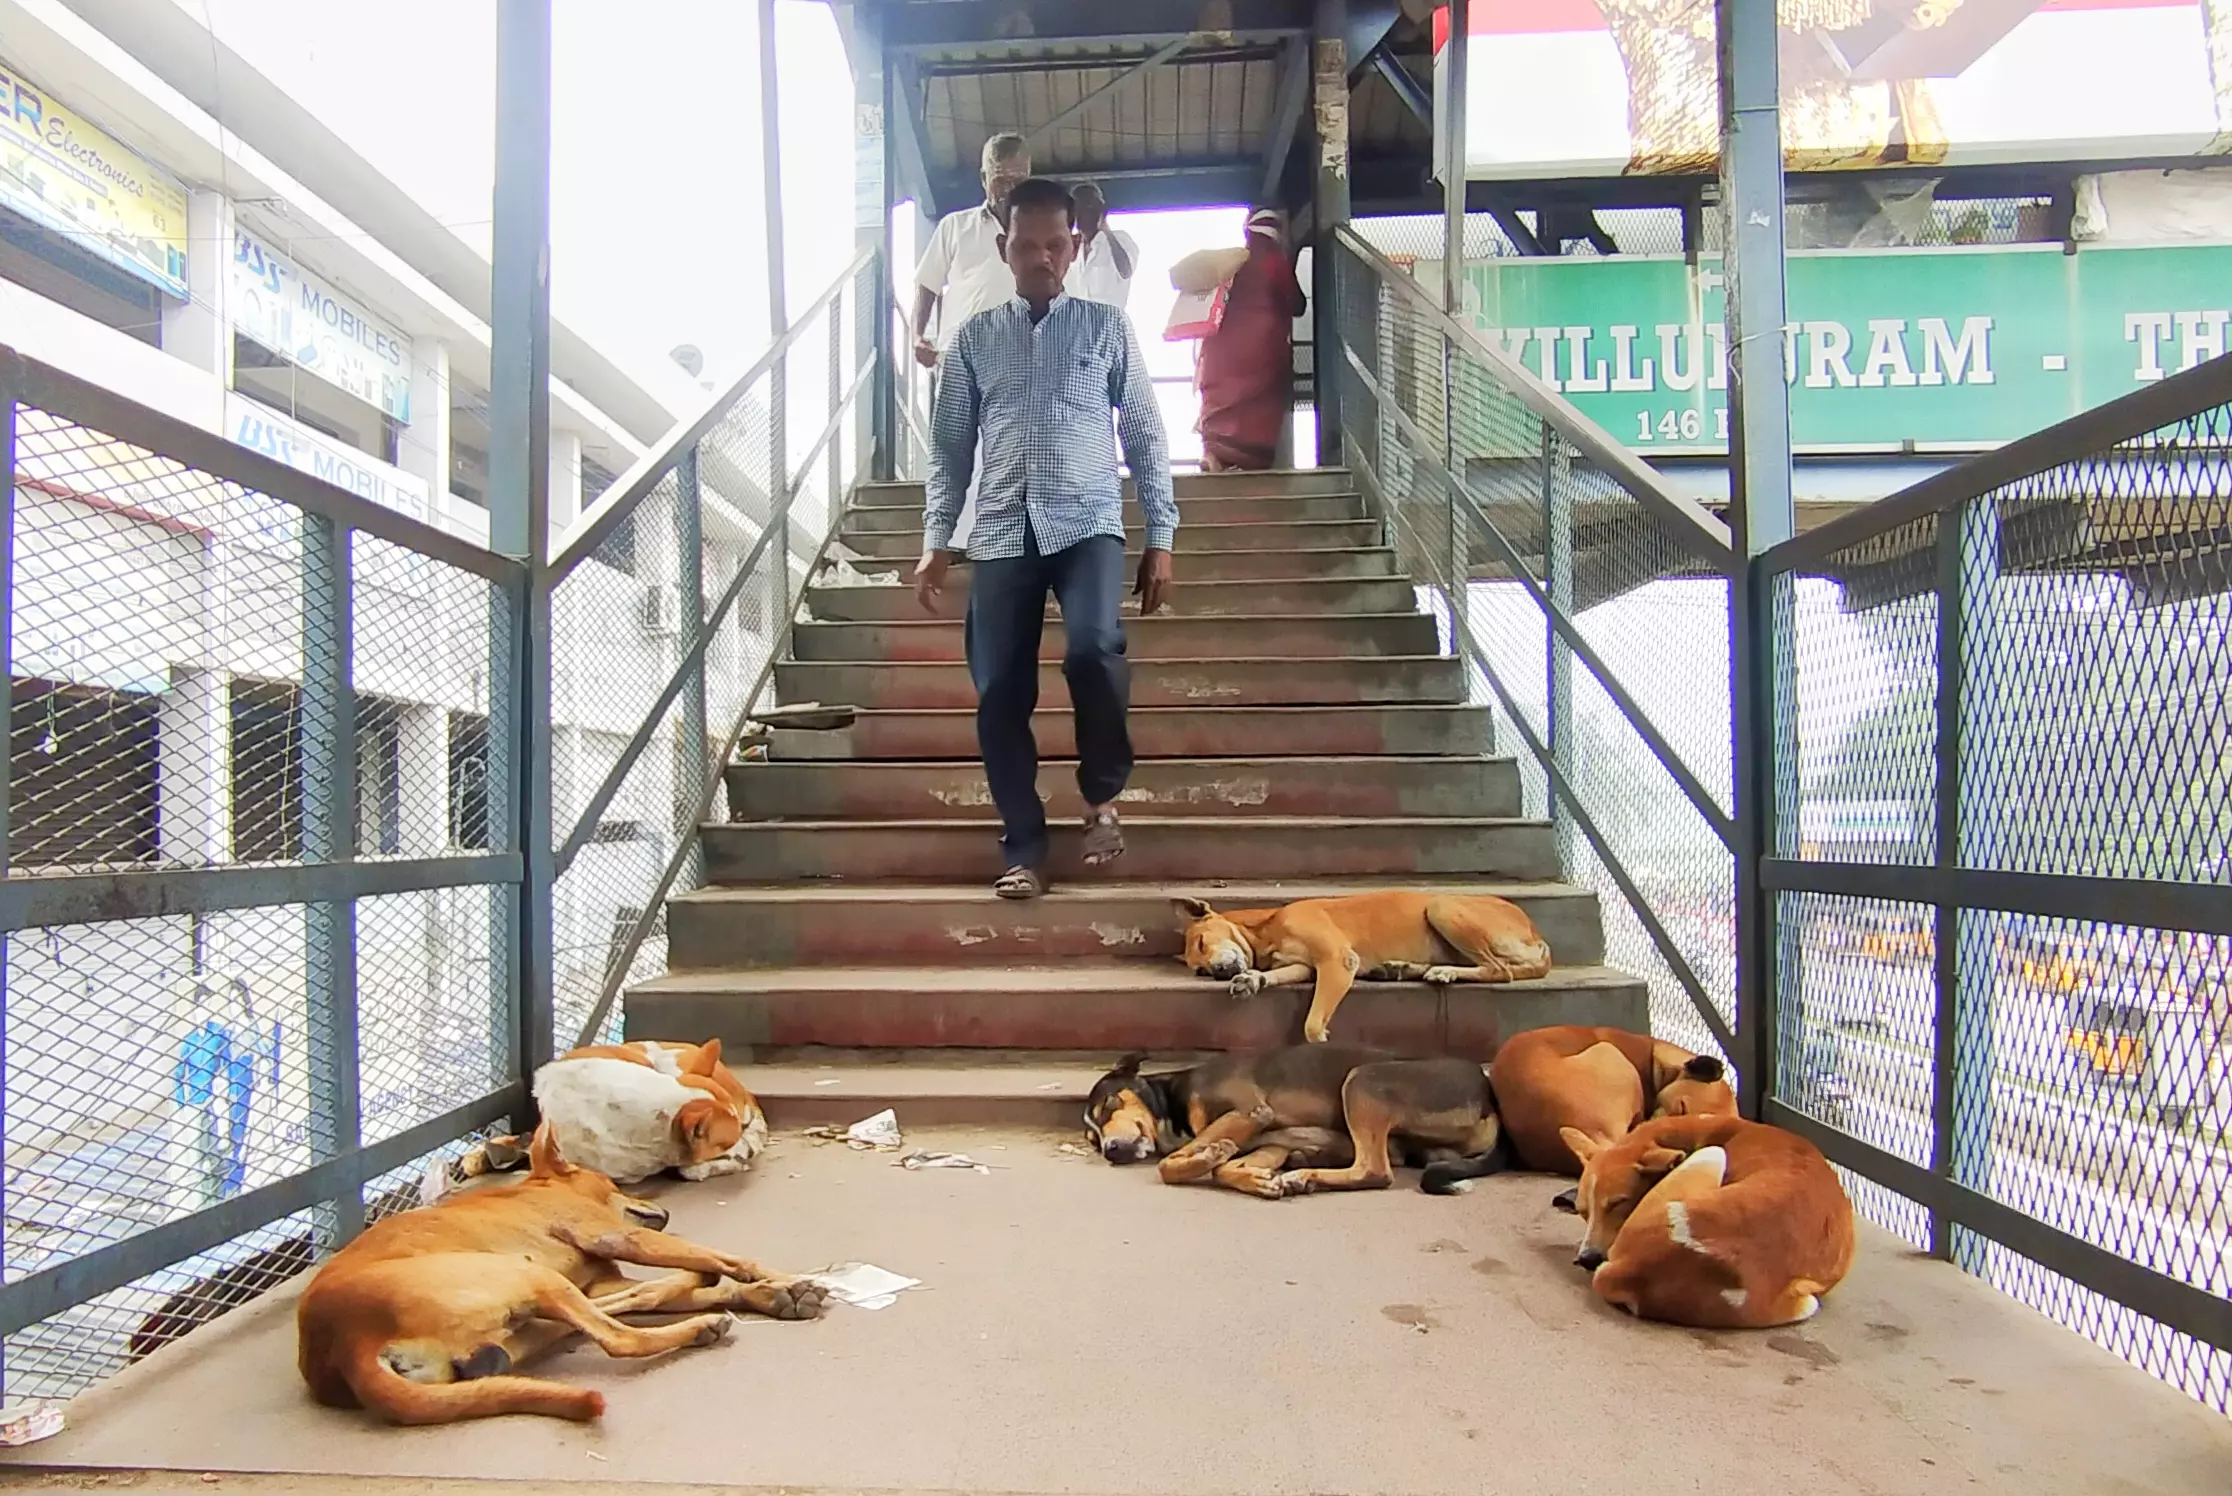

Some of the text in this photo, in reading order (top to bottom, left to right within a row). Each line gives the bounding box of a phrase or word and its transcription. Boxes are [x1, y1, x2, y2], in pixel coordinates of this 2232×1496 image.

[46, 117, 145, 198] Electronics
[301, 281, 401, 366] MOBILES
[1637, 409, 1701, 441] 146
